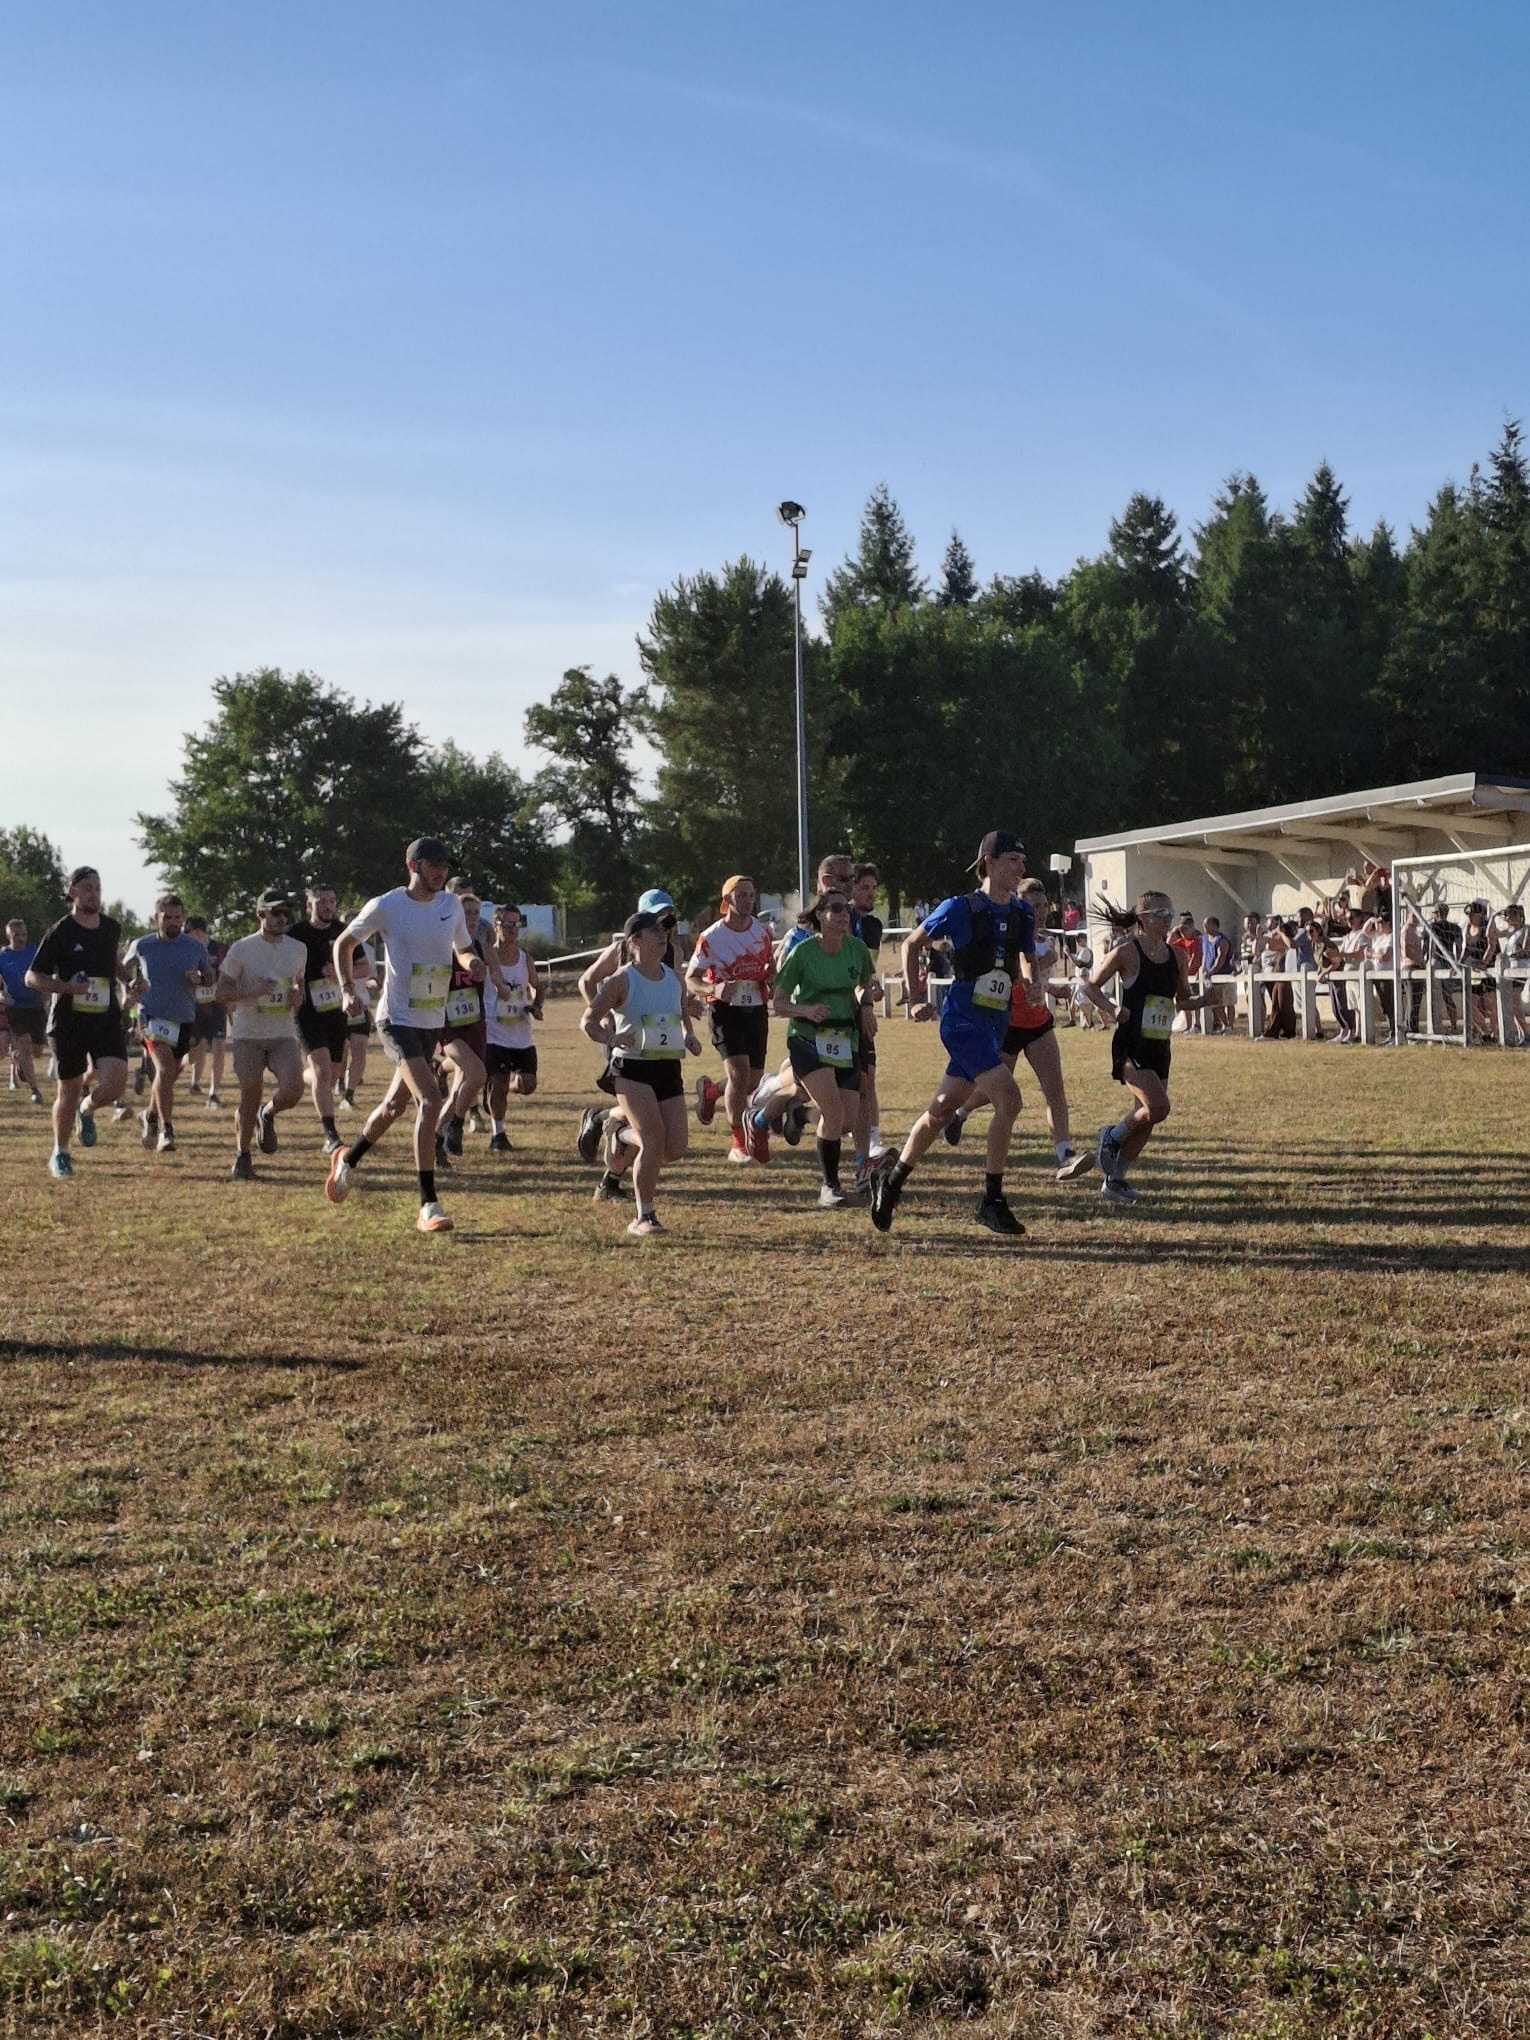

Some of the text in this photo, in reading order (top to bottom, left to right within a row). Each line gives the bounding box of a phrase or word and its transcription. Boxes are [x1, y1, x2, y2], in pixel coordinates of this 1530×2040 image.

[990, 980, 1004, 994] 30
[270, 993, 283, 1003] 32
[660, 1034, 668, 1045] 2
